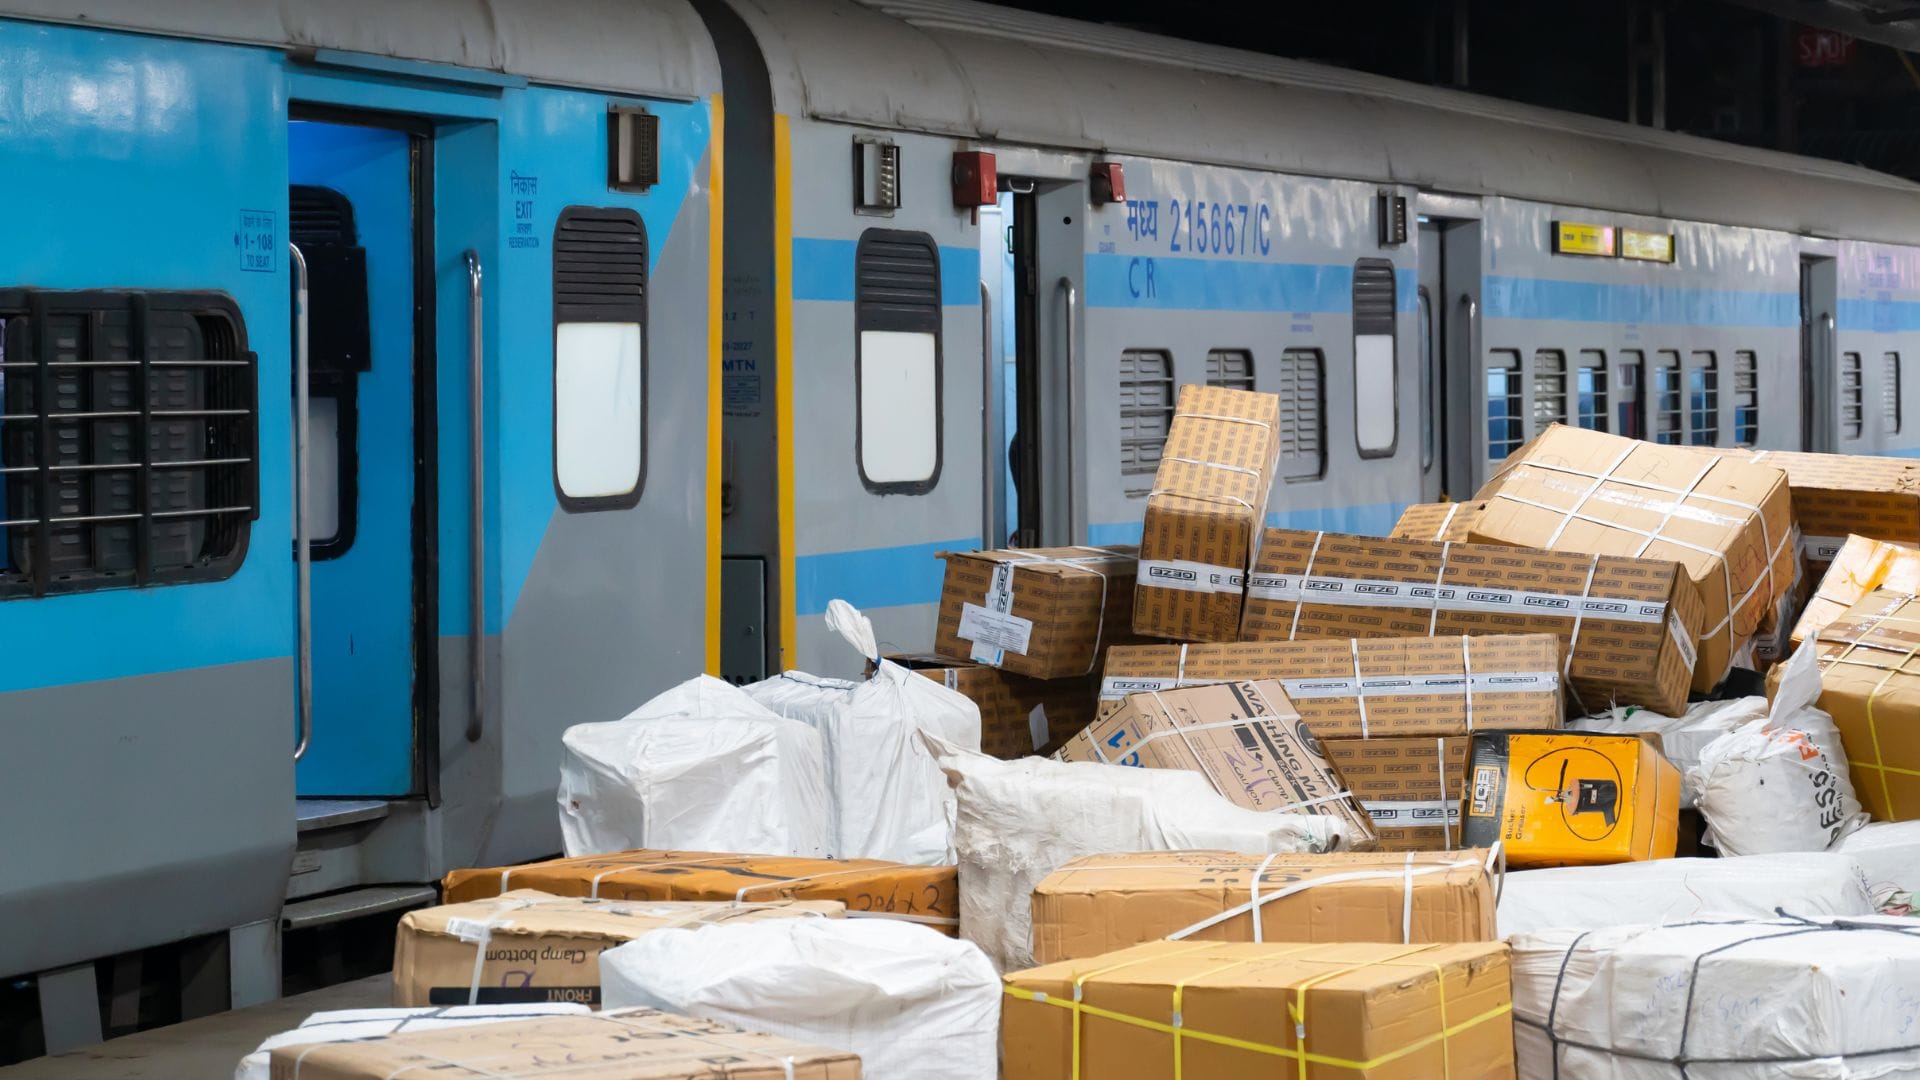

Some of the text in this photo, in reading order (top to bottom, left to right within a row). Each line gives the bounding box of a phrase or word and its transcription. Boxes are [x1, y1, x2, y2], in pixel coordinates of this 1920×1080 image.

[510, 169, 538, 195] निकास
[516, 201, 533, 219] EXIT
[1126, 199, 1270, 256] मध्य 215667/C
[246, 254, 270, 267] TO SEAT
[1151, 568, 1193, 580] GEZE
[1357, 585, 1396, 594] GEZE
[1470, 593, 1509, 602] GEZE
[1527, 598, 1566, 607] GEZE
[1585, 603, 1623, 612] GEZE
[1267, 769, 1291, 800] Clamp
[1277, 760, 1297, 786] BACK
[1474, 770, 1491, 813] JCB
[485, 946, 586, 965] Clamp bottom
[548, 989, 593, 1002] FRONT
